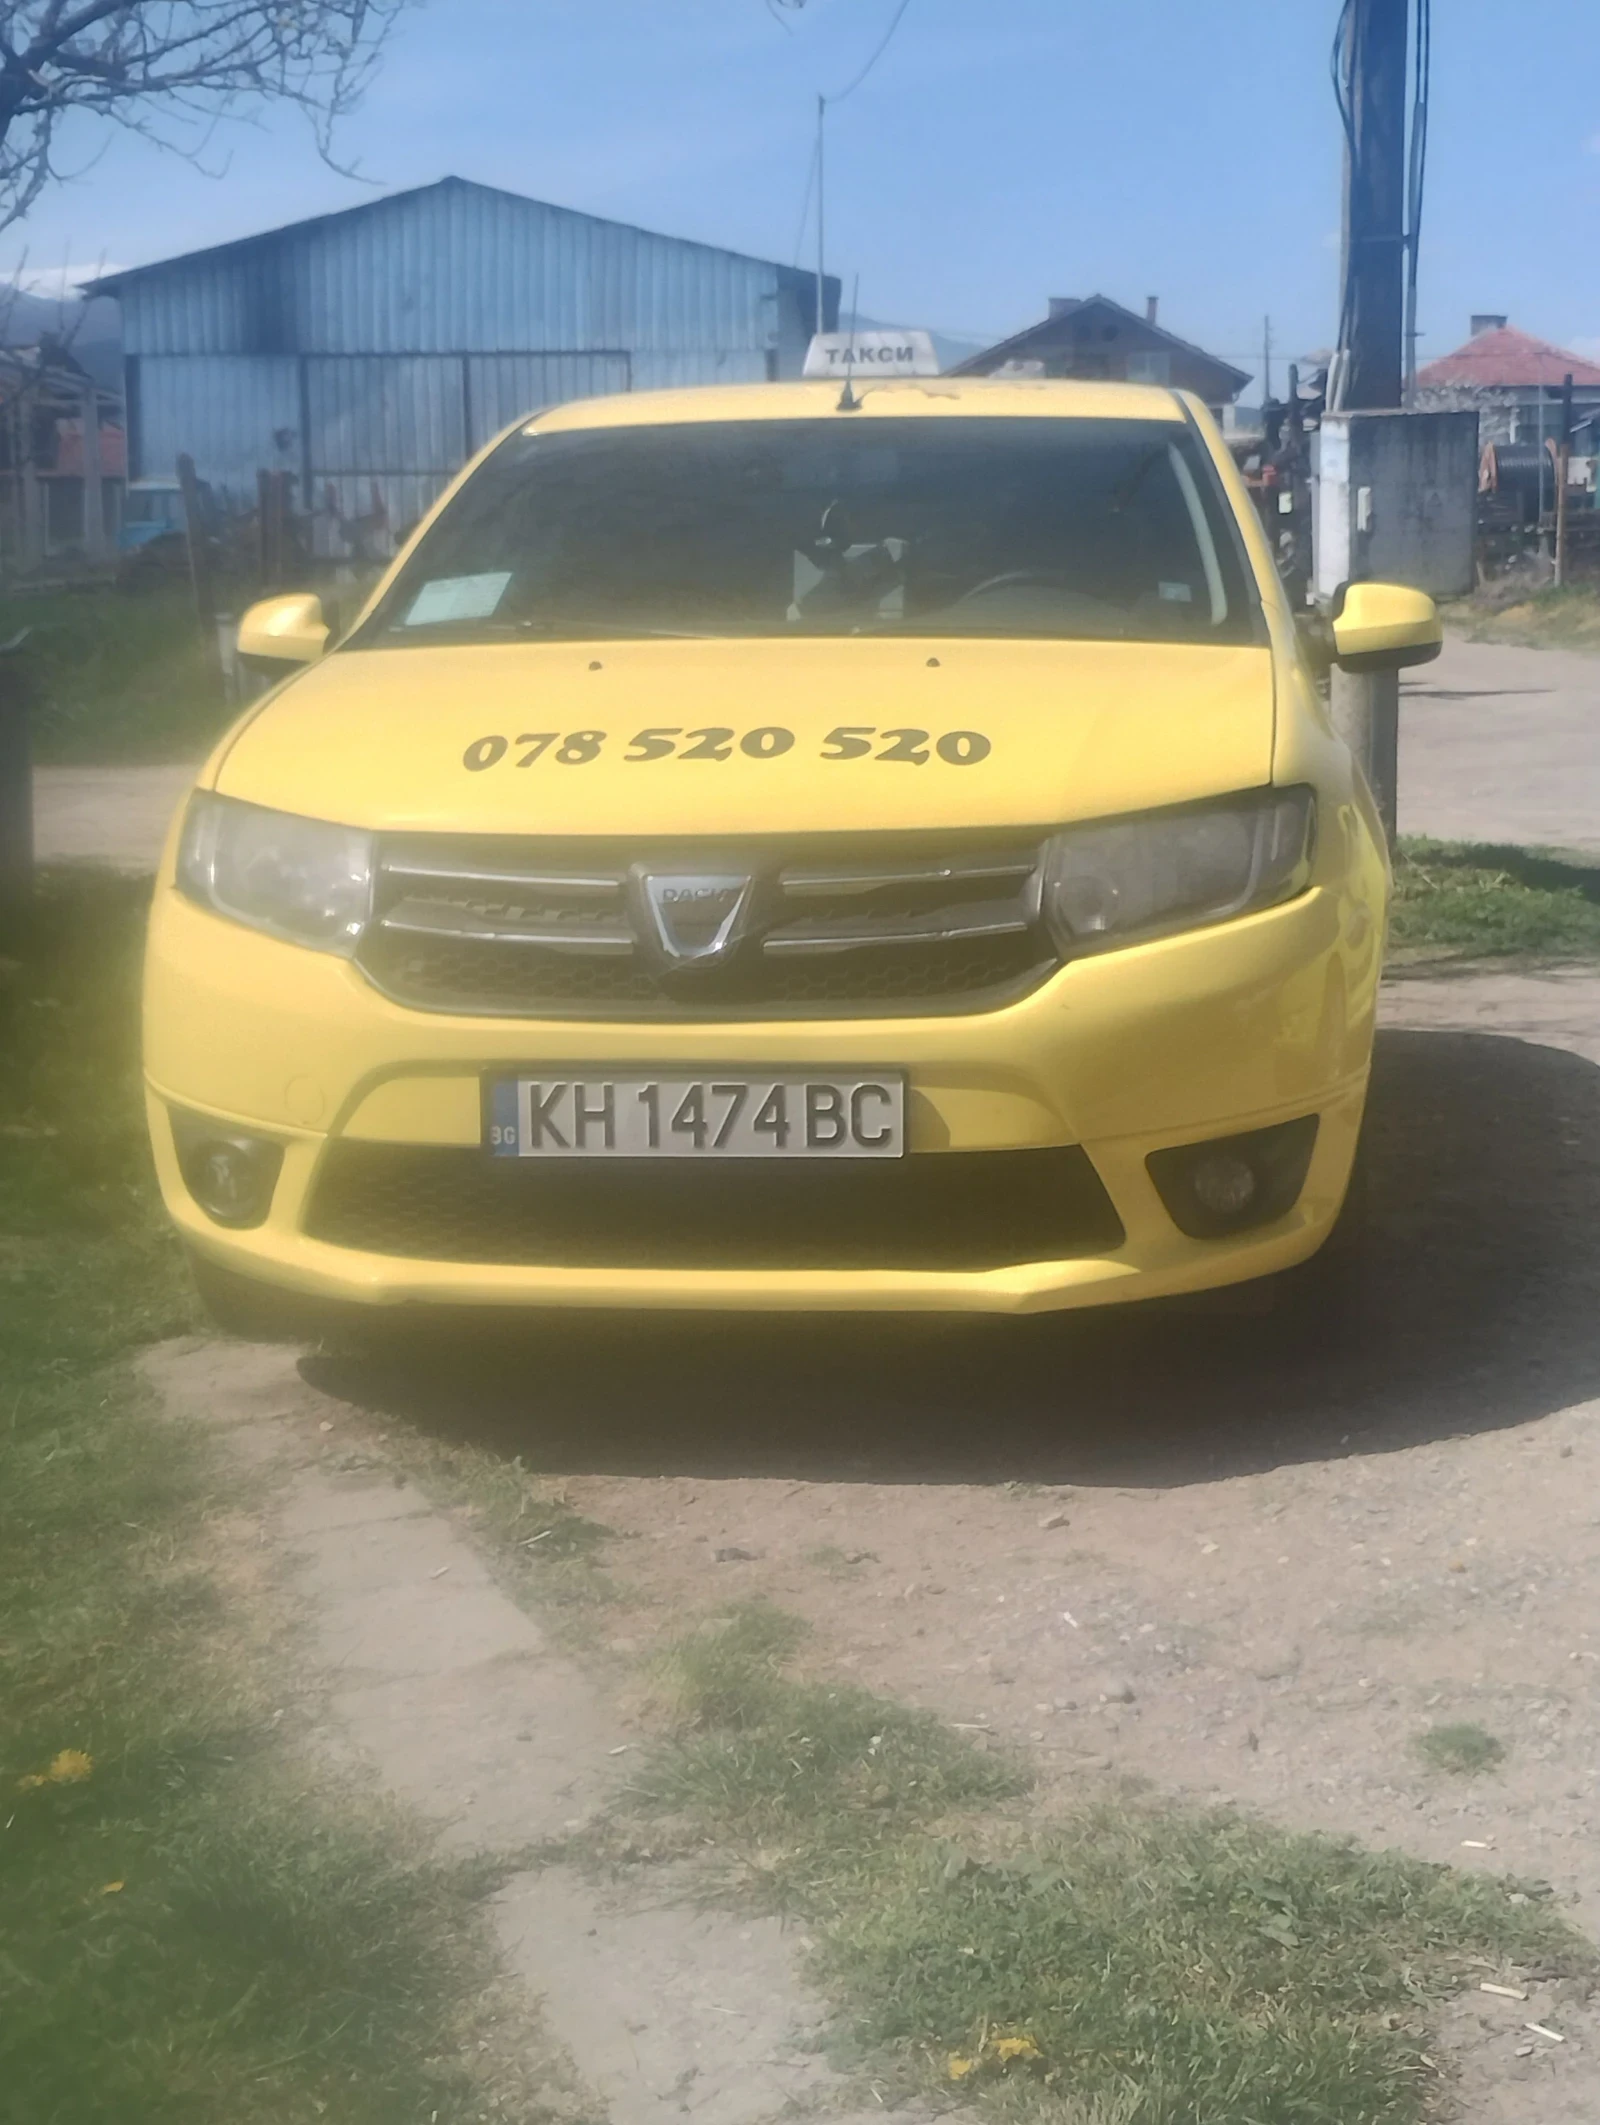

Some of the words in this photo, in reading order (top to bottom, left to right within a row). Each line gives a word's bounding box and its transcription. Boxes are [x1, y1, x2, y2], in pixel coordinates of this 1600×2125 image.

[825, 346, 914, 365] ТАКСИ
[462, 729, 608, 773] 078
[623, 726, 796, 761] 520
[819, 726, 992, 767] 520
[637, 1082, 791, 1150] 1474
